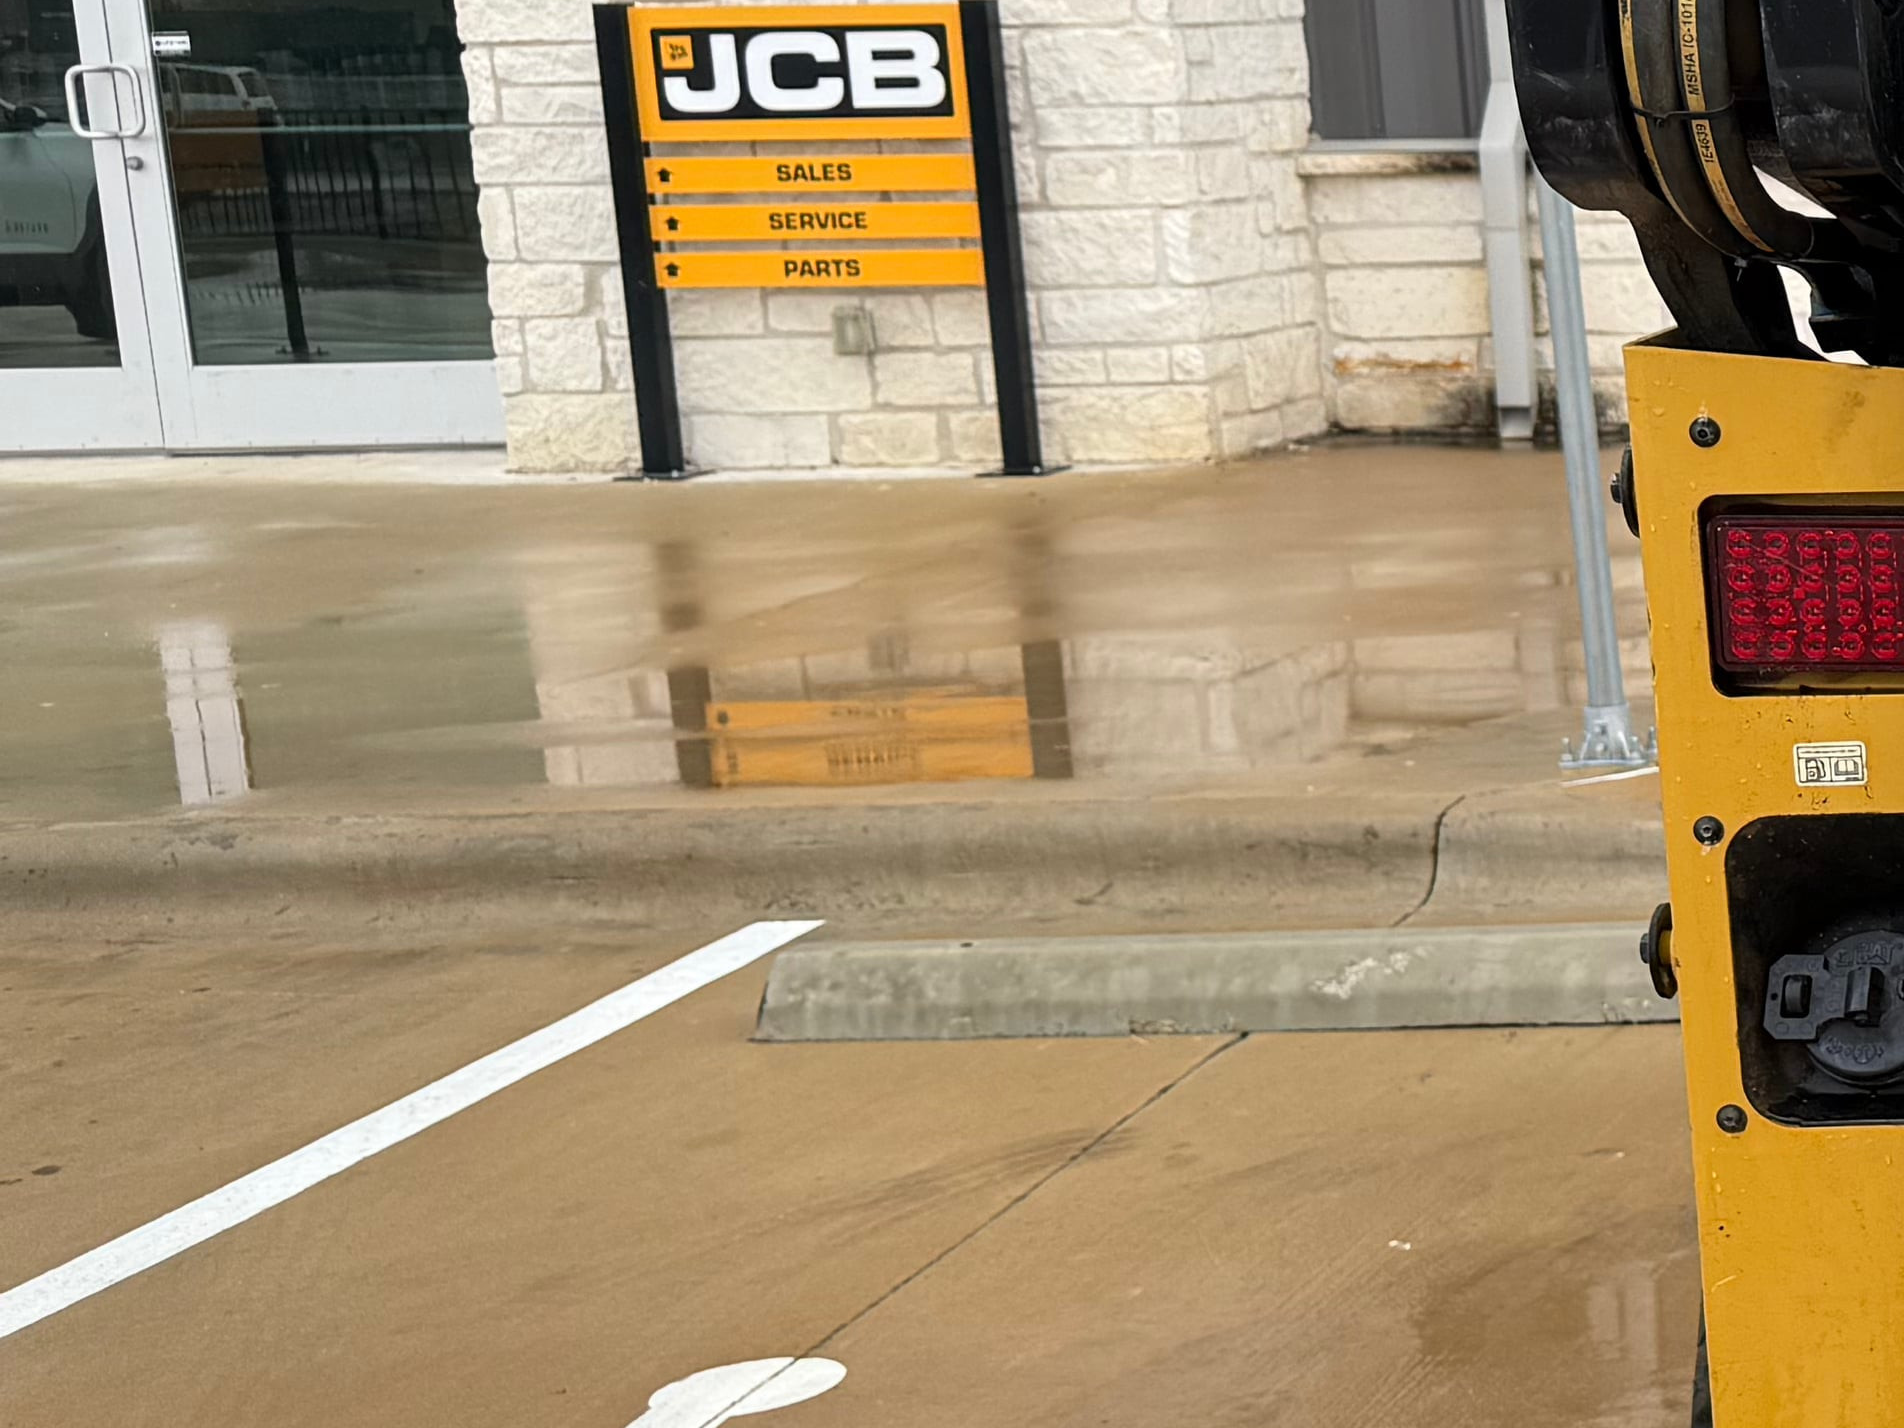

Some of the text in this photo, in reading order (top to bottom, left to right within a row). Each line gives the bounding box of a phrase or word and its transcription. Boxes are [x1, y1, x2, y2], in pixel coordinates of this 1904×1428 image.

[663, 30, 947, 112] JCB
[1682, 53, 1701, 96] MSHA
[776, 162, 853, 183] SALES
[768, 211, 869, 231] SERVICE
[783, 258, 861, 278] PARTS
